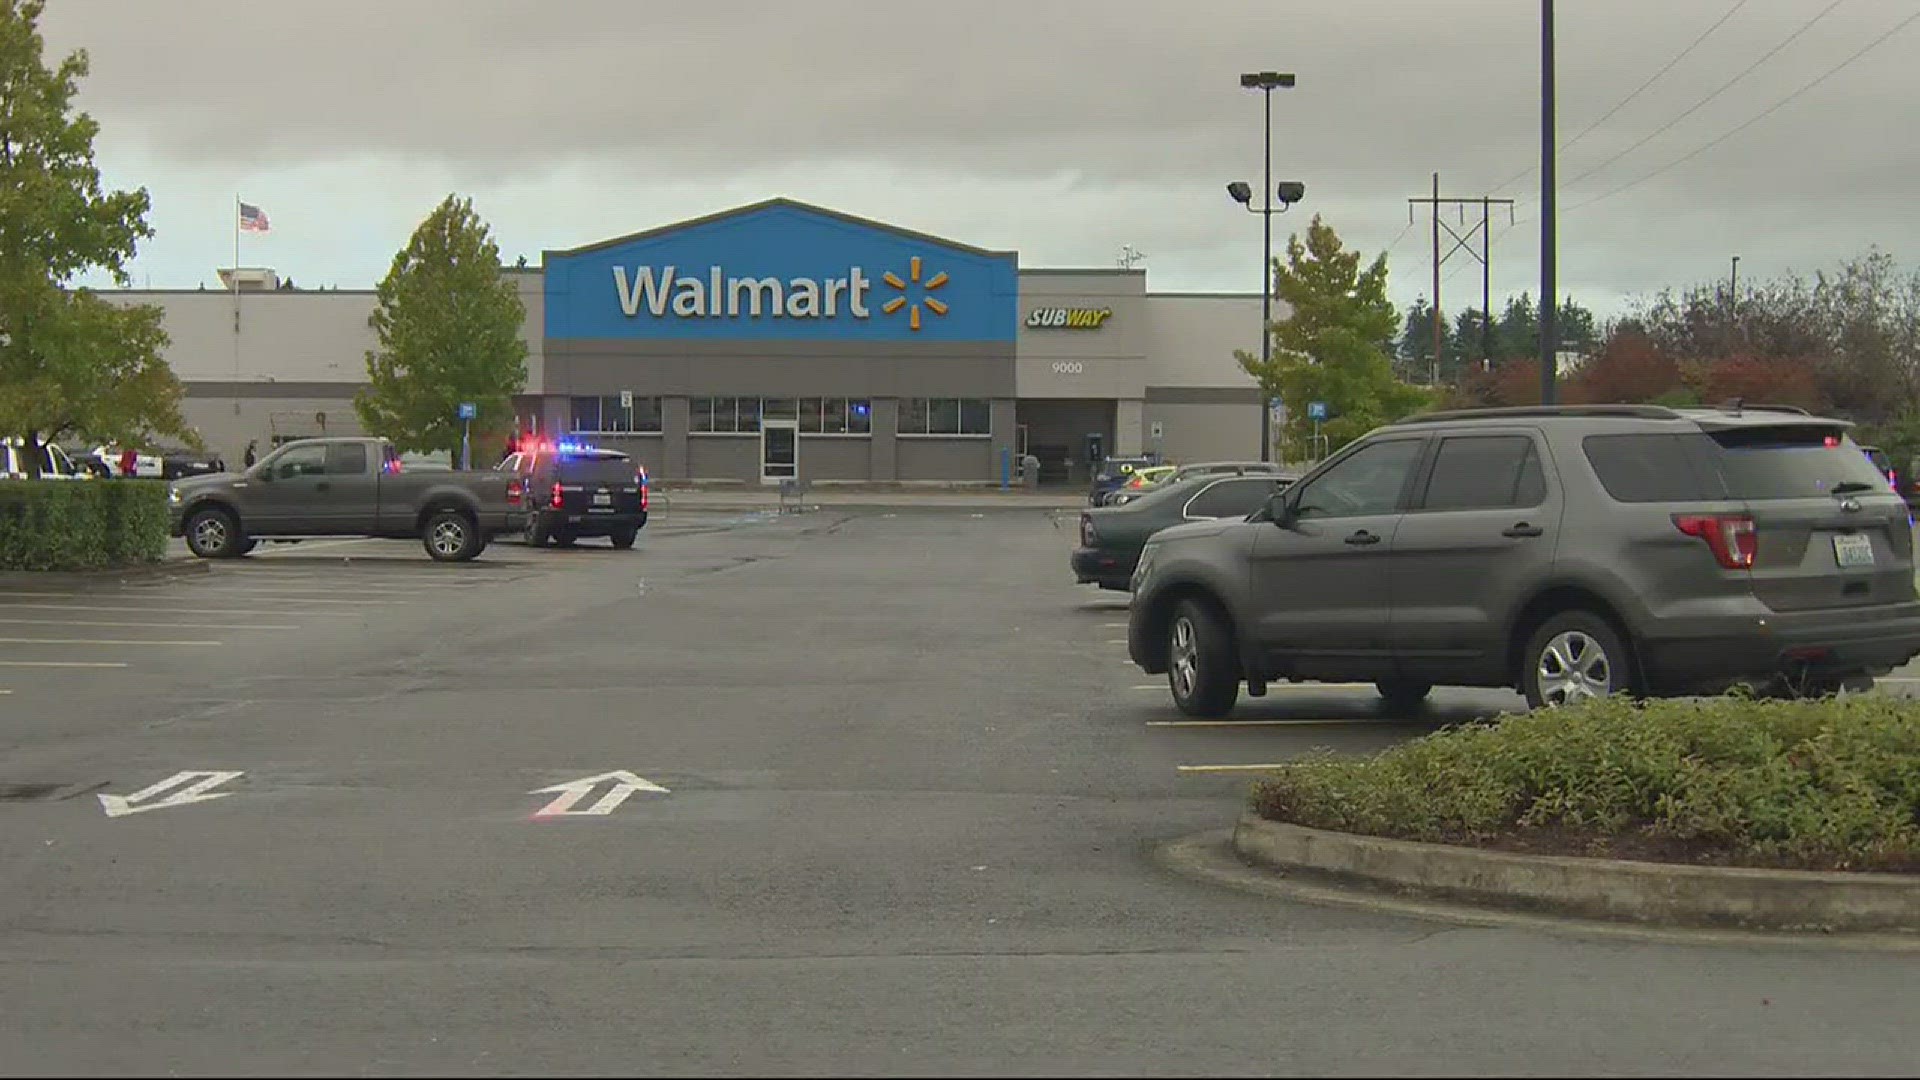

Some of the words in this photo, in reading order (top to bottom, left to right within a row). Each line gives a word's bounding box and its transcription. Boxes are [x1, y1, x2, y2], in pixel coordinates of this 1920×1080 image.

[612, 265, 870, 317] Walmart
[1026, 307, 1112, 329] SUBWAY
[1051, 361, 1083, 374] 9000
